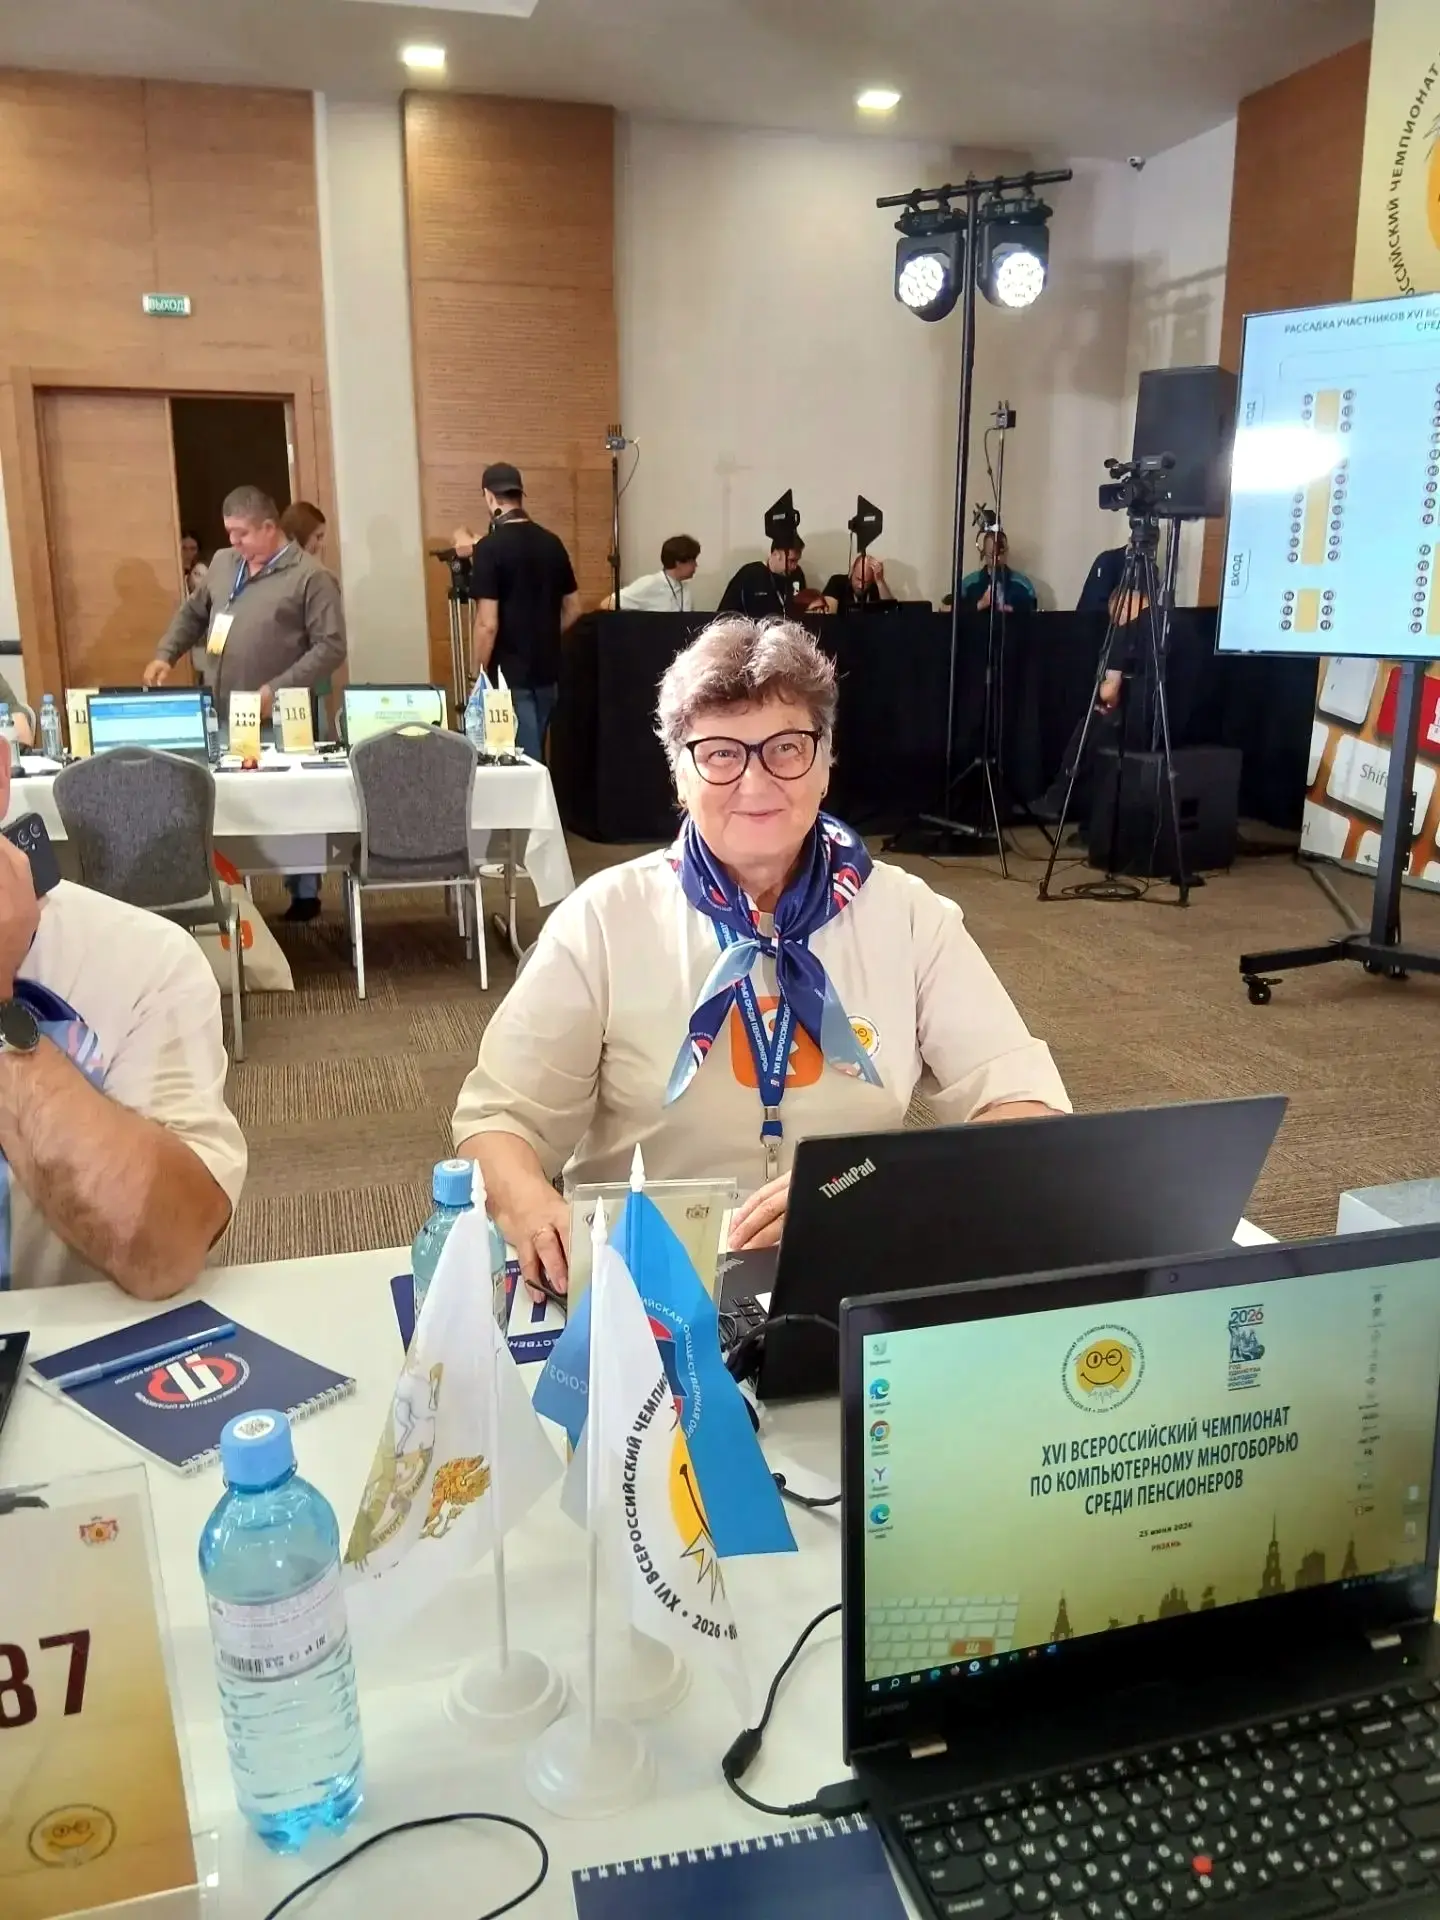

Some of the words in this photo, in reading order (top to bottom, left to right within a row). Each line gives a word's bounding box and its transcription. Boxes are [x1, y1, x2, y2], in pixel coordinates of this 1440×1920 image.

[1390, 62, 1438, 191] ЧЕМПИОНАТ
[1386, 198, 1415, 296] ОССИЙСКИЙ
[148, 297, 185, 312] ВЫХОД
[1284, 320, 1335, 334] РАССАДКА
[1337, 314, 1404, 328] УЧАСТНИКОВ
[1407, 310, 1423, 320] XVI
[1231, 553, 1243, 586] ВХОД
[285, 707, 306, 720] 116
[489, 709, 509, 723] 115
[773, 1062, 781, 1074] XVI
[819, 1158, 876, 1198] ThinkPad
[1231, 1308, 1264, 1324] 2026
[683, 1324, 702, 1420] ОБЩЕСТВЕННАЯ
[1042, 1443, 1067, 1466] XVI
[1071, 1417, 1197, 1461] ВСЕРОССИЙСКИЙ
[1202, 1406, 1291, 1439] ЧЕМПИОНАТ
[1030, 1474, 1052, 1497] ПО
[1056, 1450, 1194, 1492] КОМПЬЮТЕРНОМУ
[1197, 1432, 1299, 1468] МНОГОБОРЬЮ
[1085, 1487, 1133, 1516] СРЕДИ
[1137, 1468, 1244, 1507] ПЕНСИОНЕРОВ
[622, 1436, 660, 1585] ВСЕРОССИЙСКИЙ
[654, 1582, 681, 1613] XVI
[691, 1614, 721, 1639] 2026
[0, 1629, 90, 1729] 87
